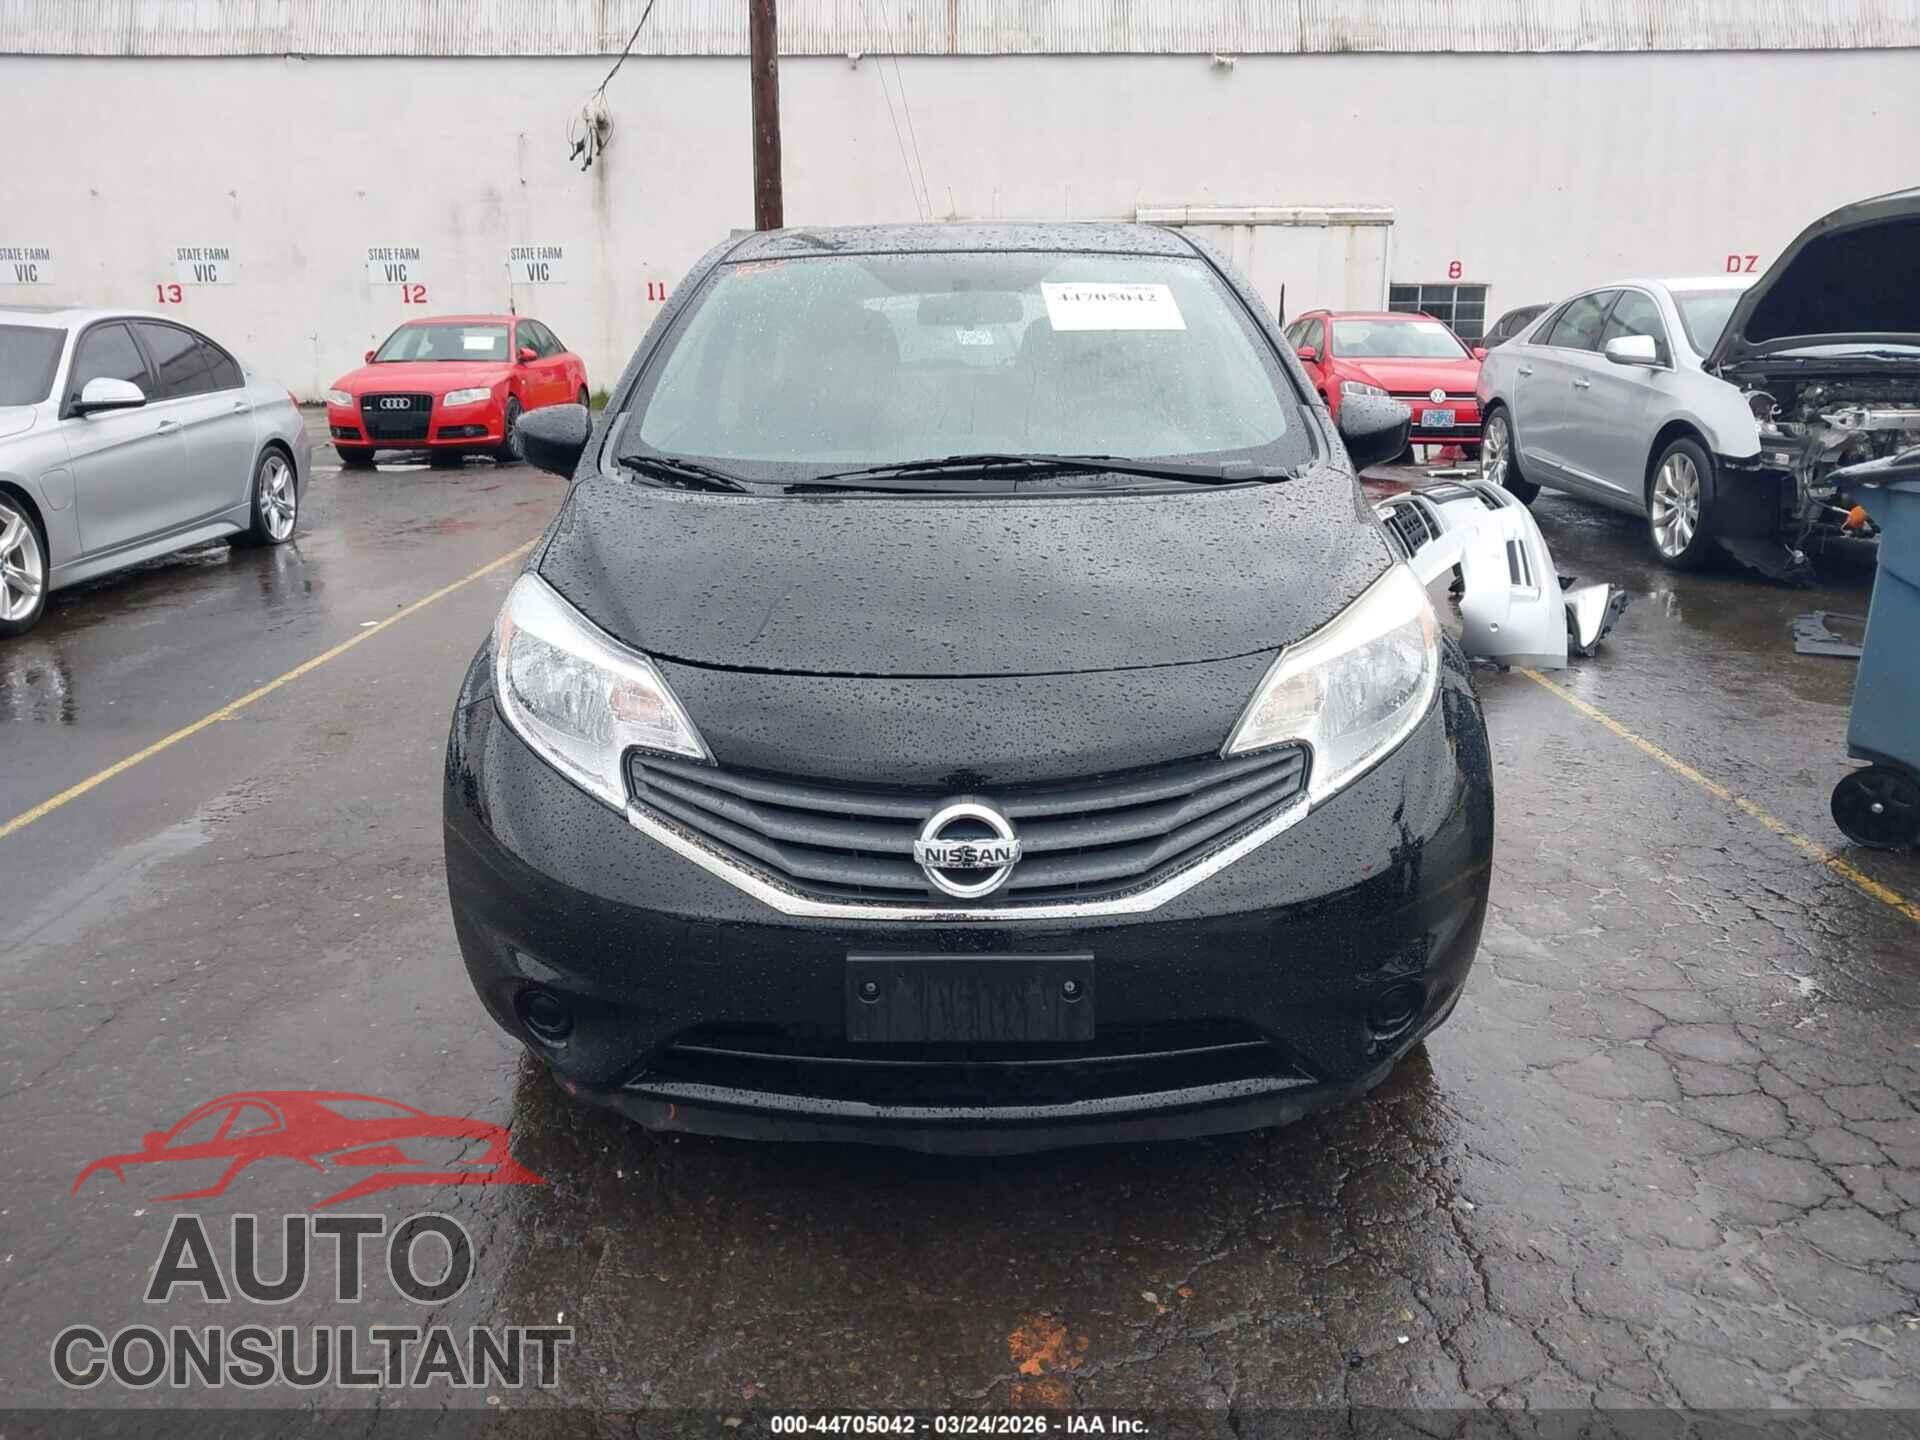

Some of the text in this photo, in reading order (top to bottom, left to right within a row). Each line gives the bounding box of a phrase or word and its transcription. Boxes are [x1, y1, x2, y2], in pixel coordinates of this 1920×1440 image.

[24, 247, 50, 261] FARM
[177, 247, 230, 261] STATE FARM
[367, 247, 420, 261] STATE FARM
[510, 246, 563, 261] STATE FARM
[14, 263, 38, 282] VIC
[194, 263, 217, 282] VIC
[384, 263, 407, 282] VIC
[526, 262, 550, 282] VIC
[1448, 260, 1462, 279] 8
[157, 284, 182, 304] 13
[402, 284, 427, 304] 12
[647, 282, 666, 301] 11
[925, 847, 1010, 863] NISSAN
